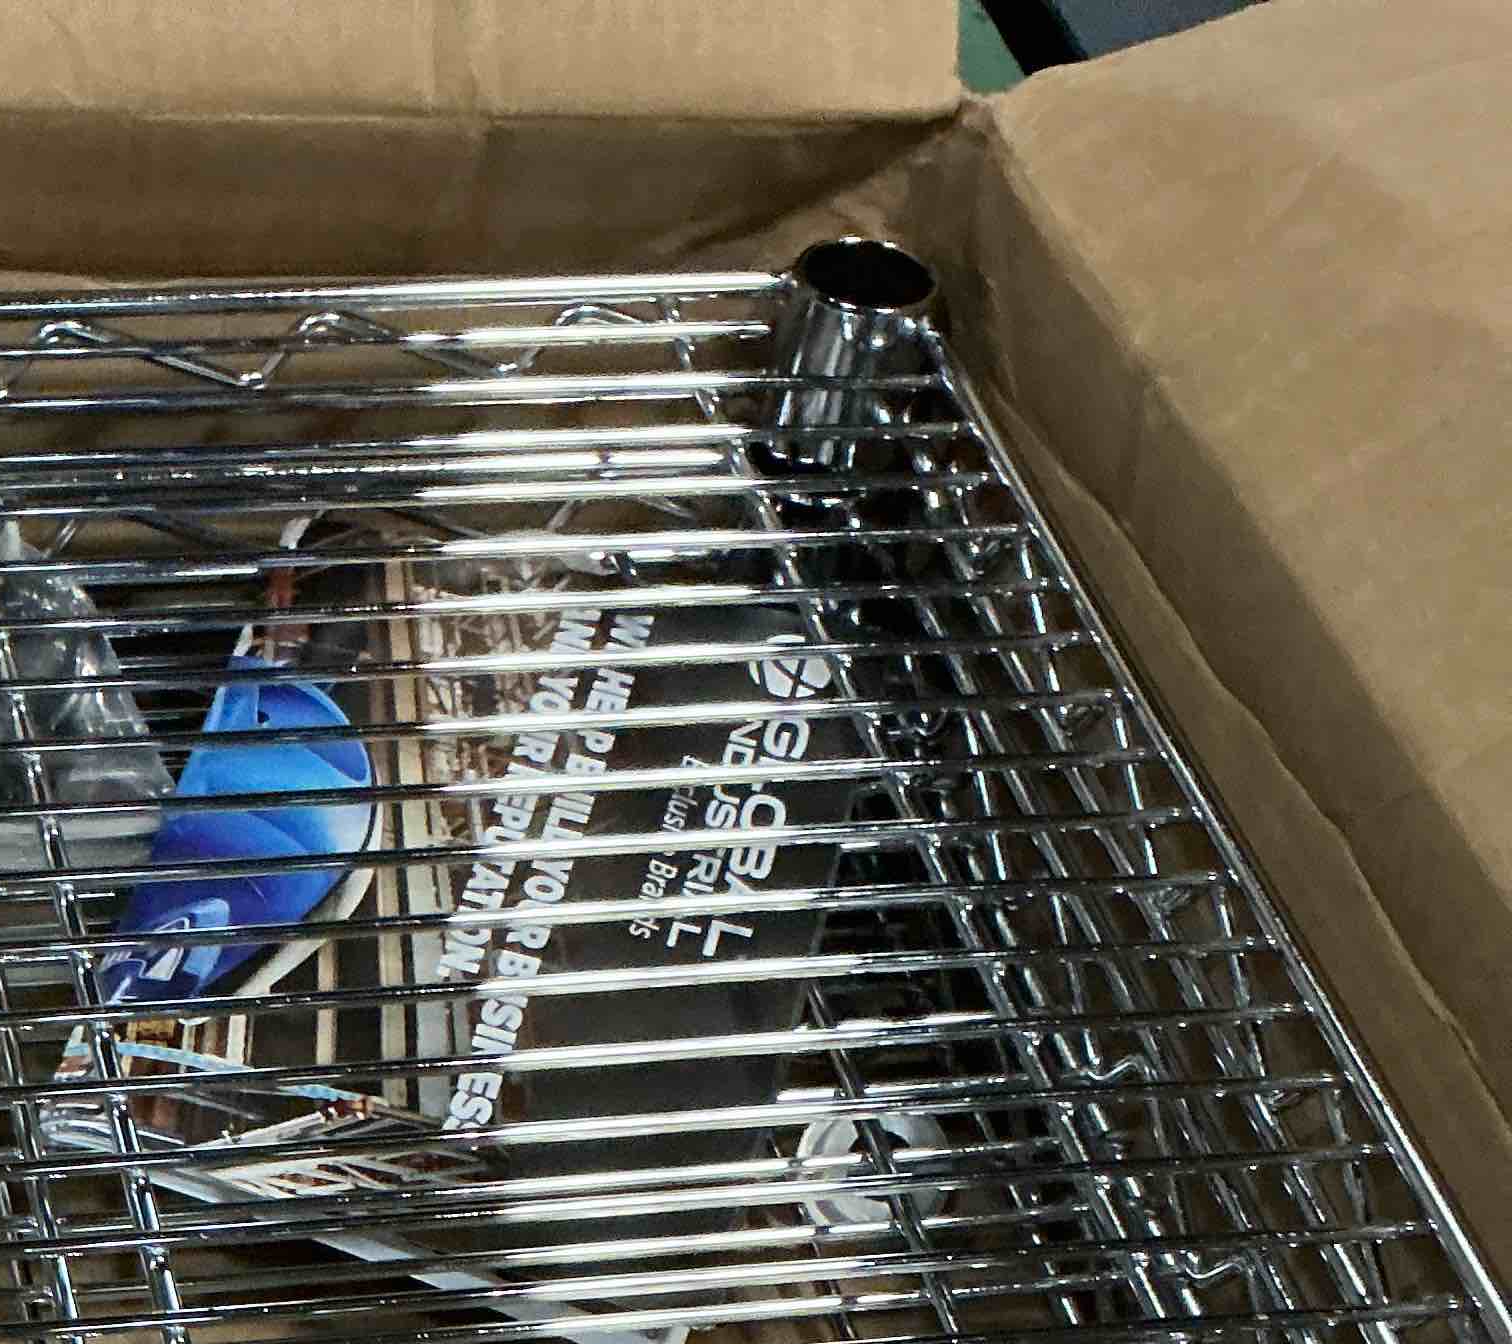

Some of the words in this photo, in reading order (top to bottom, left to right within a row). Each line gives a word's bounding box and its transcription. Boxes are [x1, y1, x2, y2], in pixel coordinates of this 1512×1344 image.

[575, 667, 636, 754] HEP
[666, 708, 769, 948] NDSRIL
[629, 859, 678, 939] Brads
